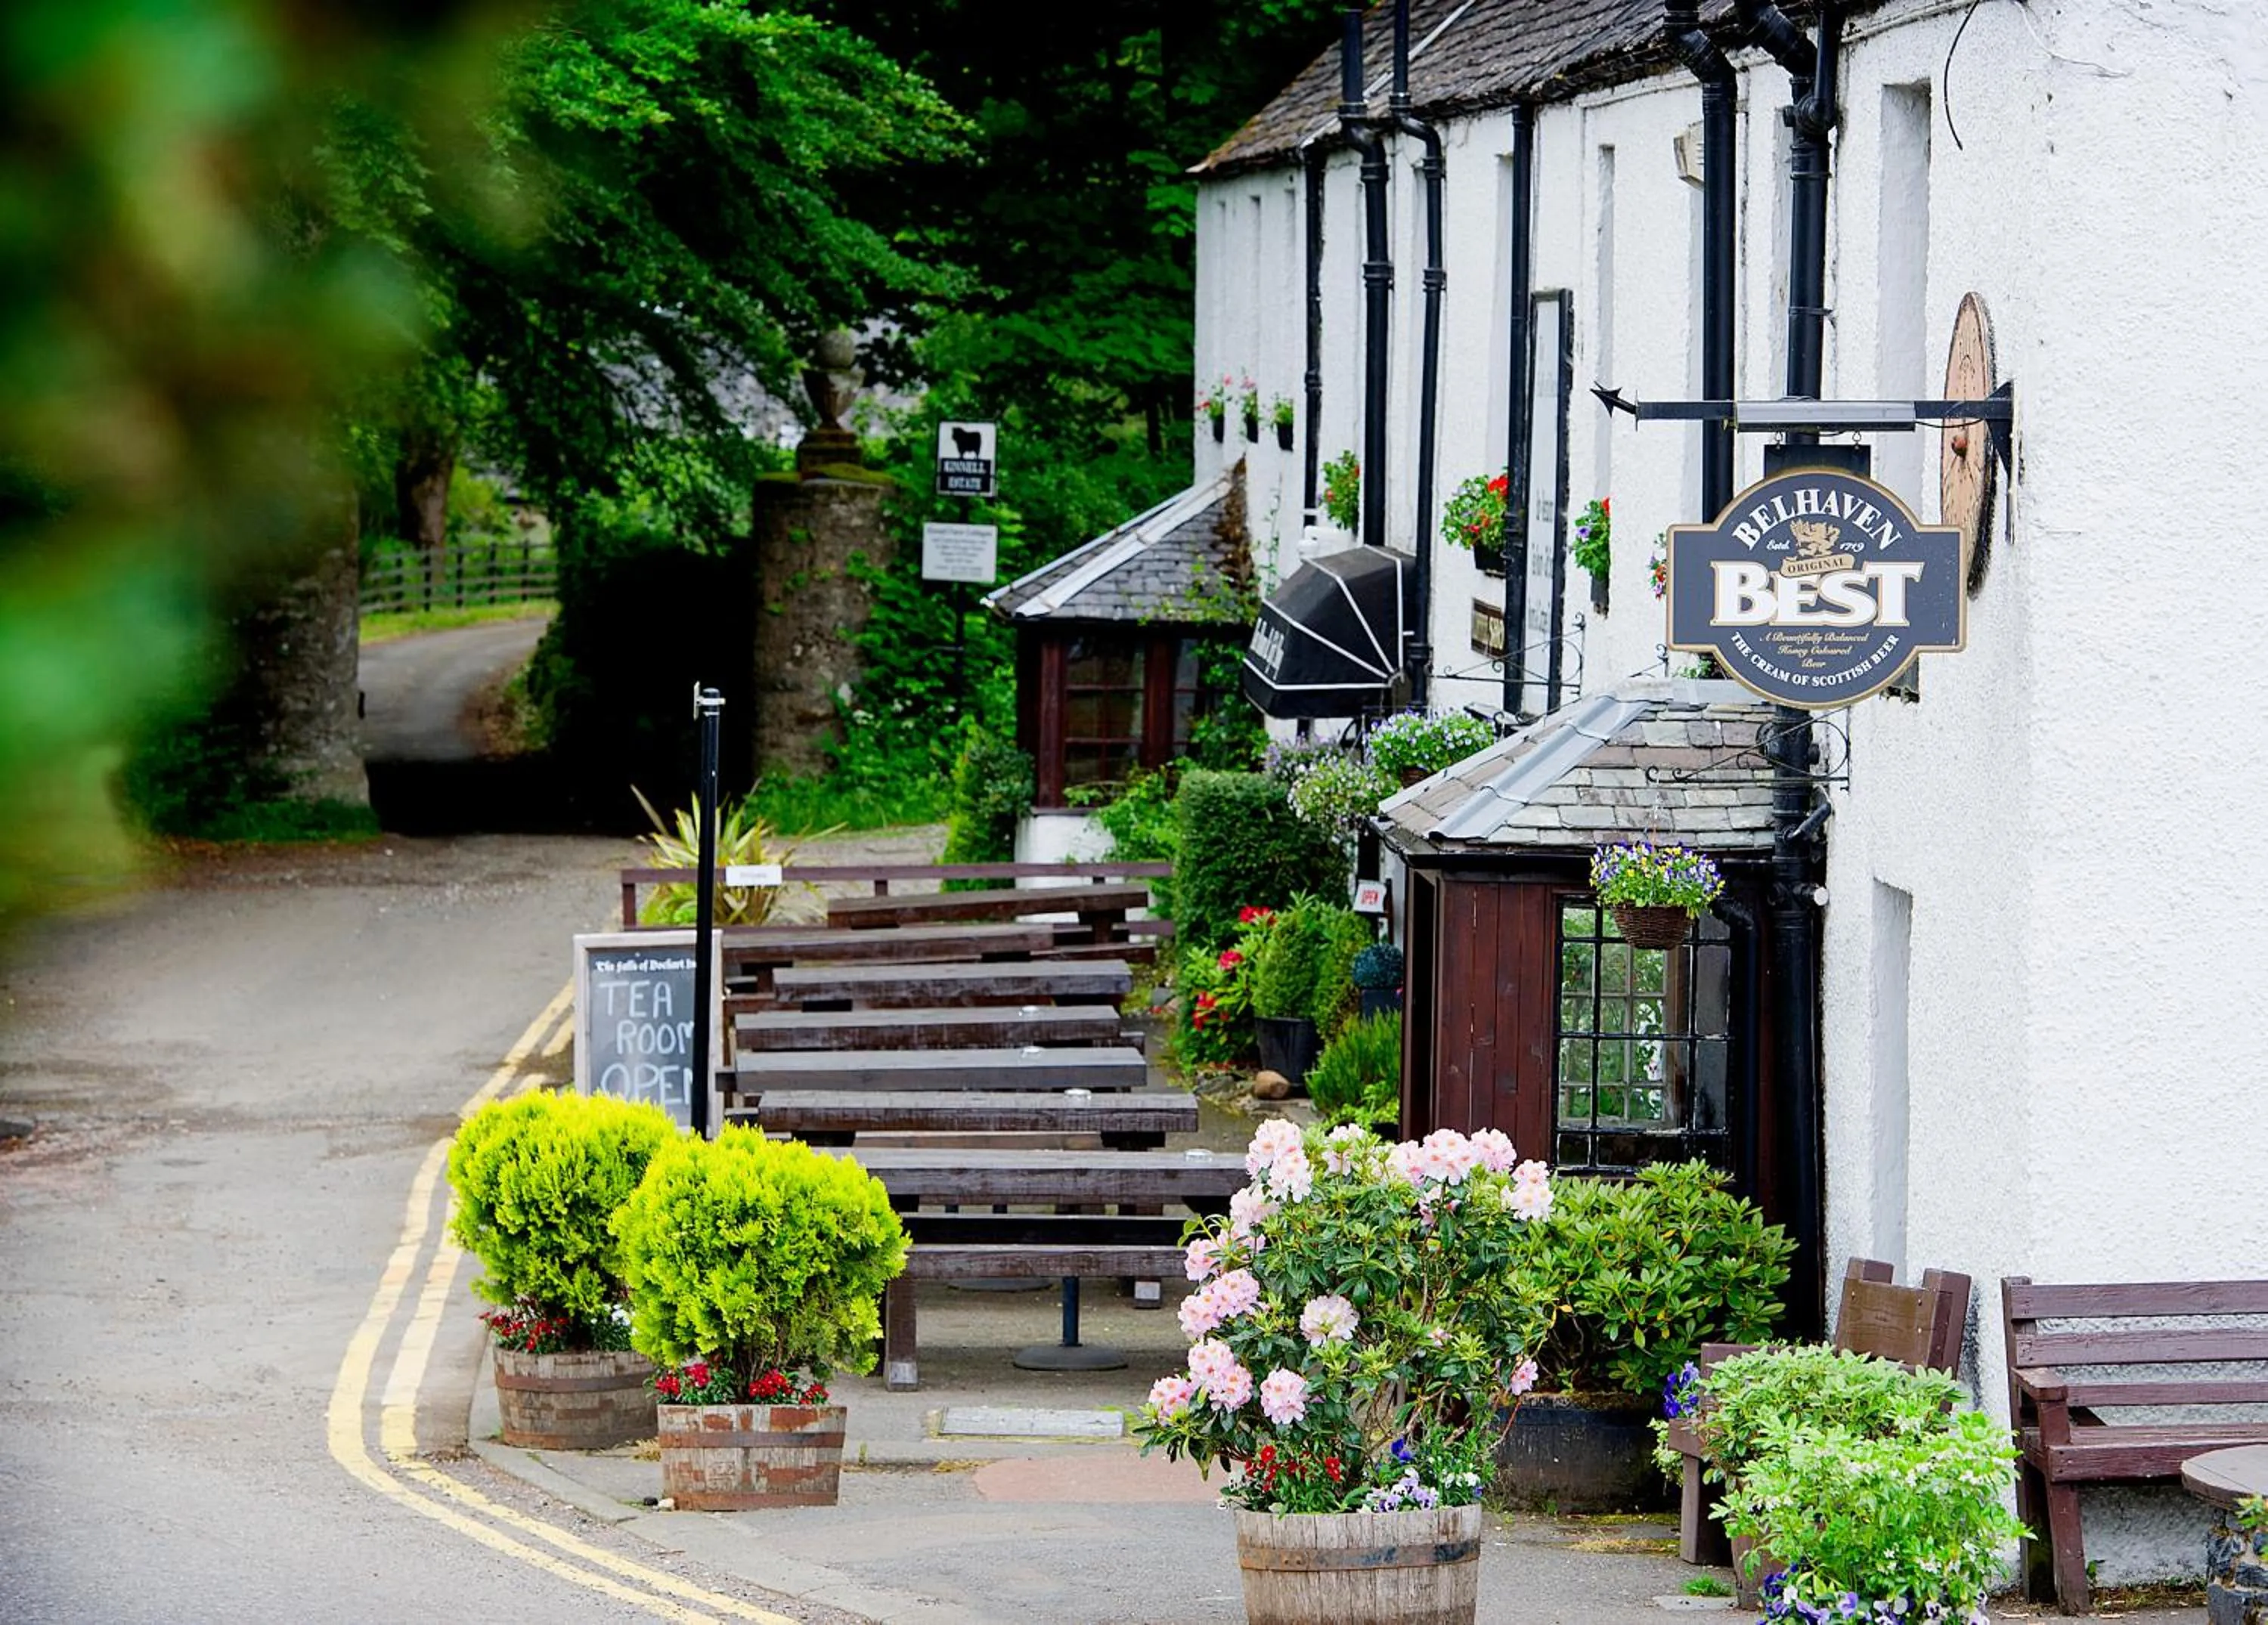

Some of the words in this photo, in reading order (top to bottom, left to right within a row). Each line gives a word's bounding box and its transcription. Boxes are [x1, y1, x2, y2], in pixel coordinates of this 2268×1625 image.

[1731, 489, 1903, 550] BELHAVEN
[1839, 542, 1864, 552] 1719
[1787, 557, 1847, 573] ORIGINAL
[1710, 562, 1925, 627] BEST
[1824, 633, 1869, 642] Balanced
[1730, 632, 1749, 658] THE
[1750, 653, 1789, 683] CREAM
[1792, 673, 1809, 686] OF
[1811, 661, 1872, 687] SCOTTISH
[1870, 634, 1900, 665] BEER
[1802, 658, 1826, 668] Beer
[599, 980, 673, 1019] TEA
